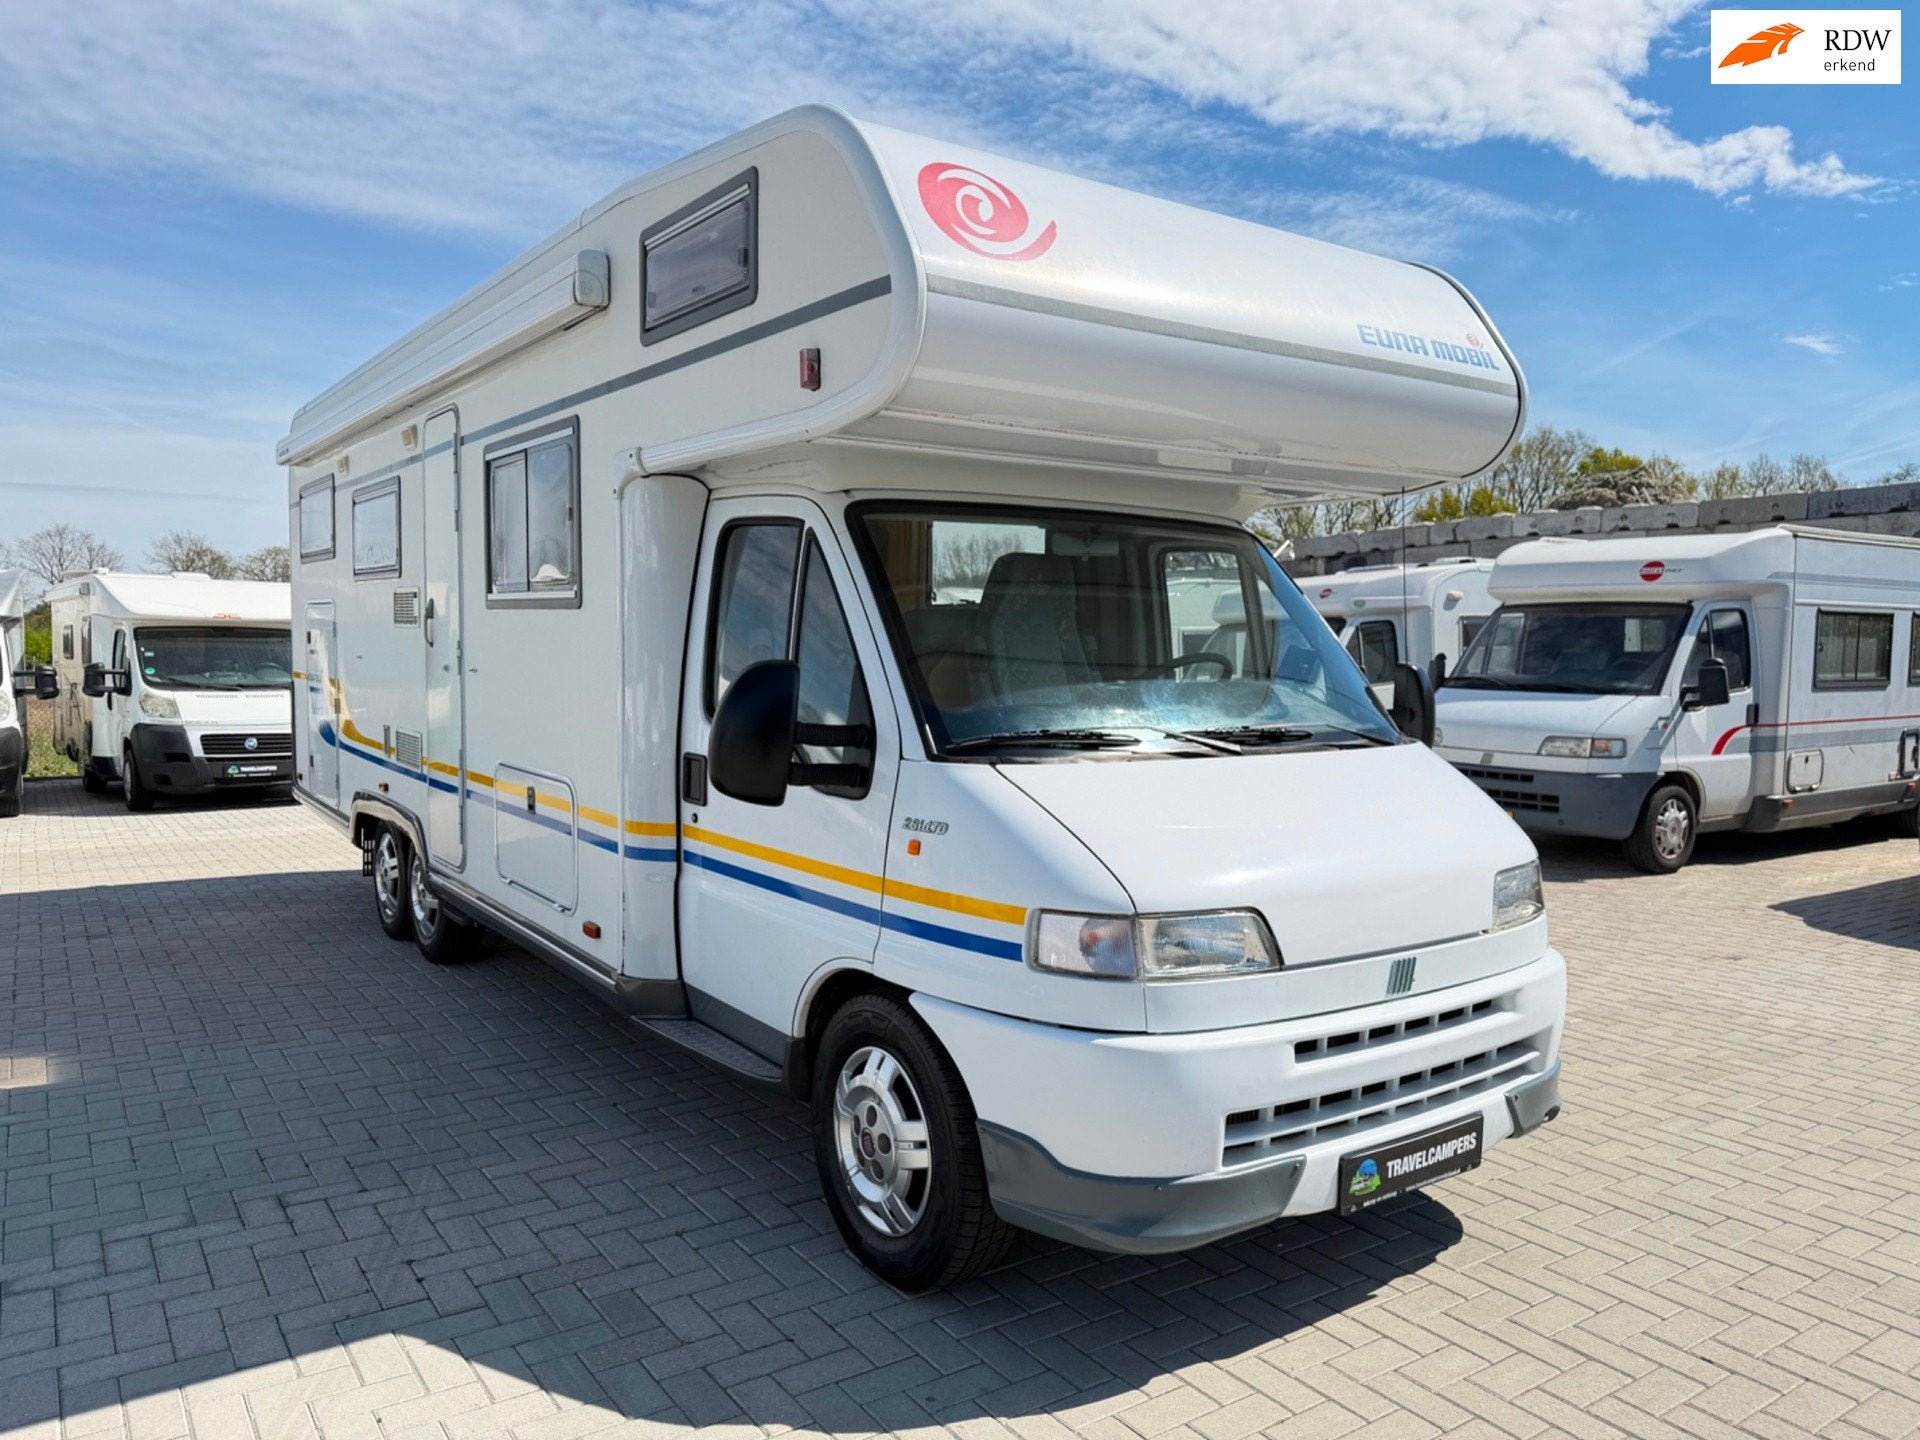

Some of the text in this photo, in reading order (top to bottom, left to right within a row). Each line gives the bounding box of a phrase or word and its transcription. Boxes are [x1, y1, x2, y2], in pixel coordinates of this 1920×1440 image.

[1356, 324, 1500, 370] EURA MOBIL
[1386, 1131, 1477, 1179] TRAVELCAMPERS
